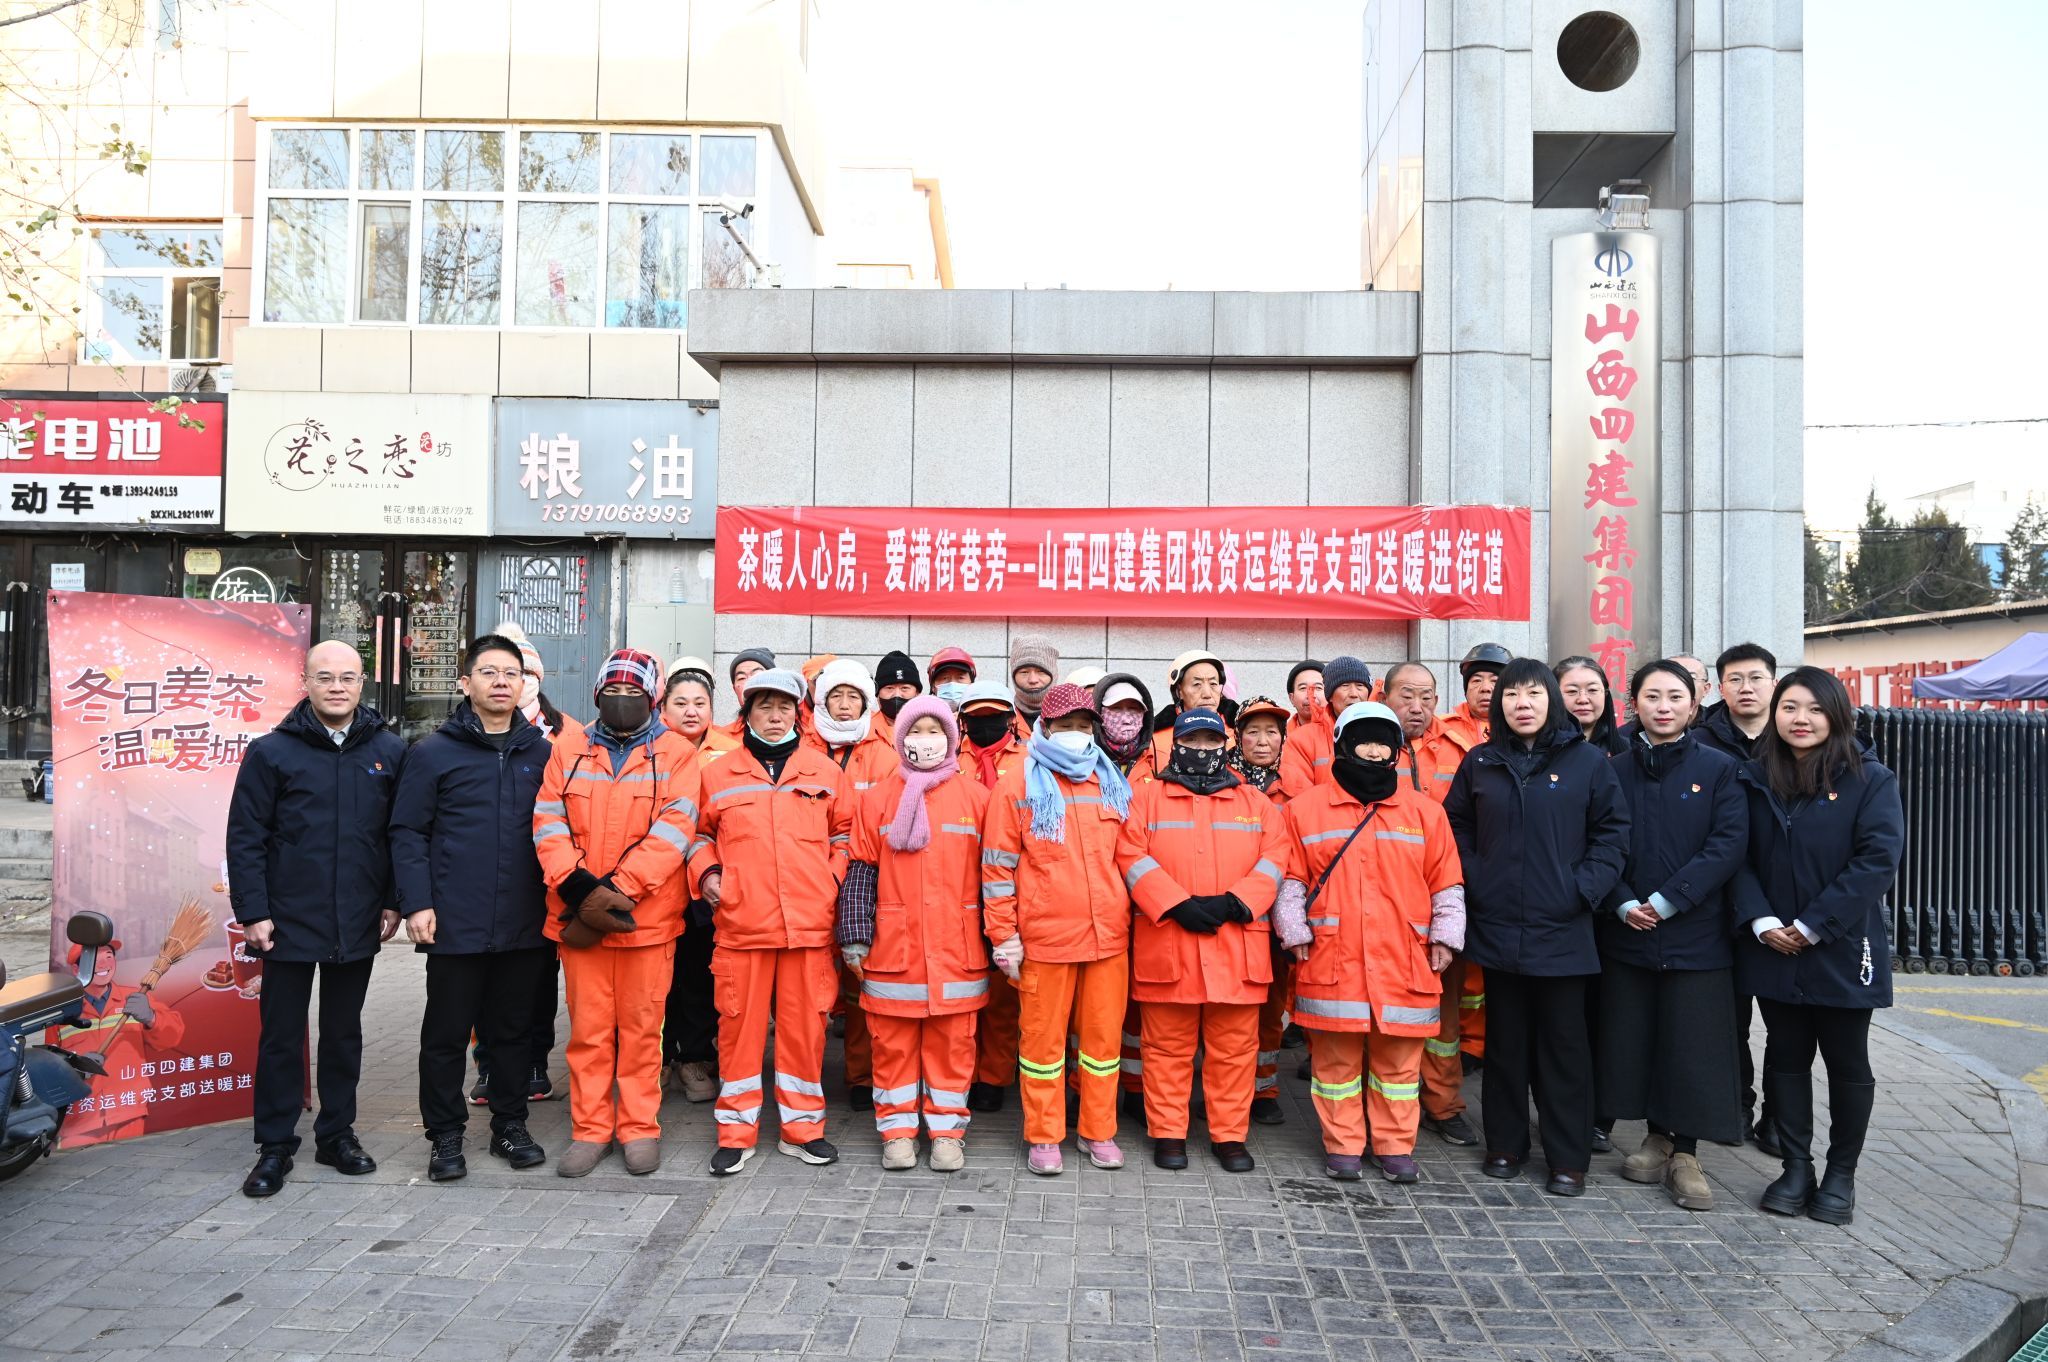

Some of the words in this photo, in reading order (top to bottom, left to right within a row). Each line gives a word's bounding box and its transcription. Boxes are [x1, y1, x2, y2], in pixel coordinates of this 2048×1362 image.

[285, 434, 417, 479] 花之恋
[519, 432, 694, 500] 粮油
[100, 485, 123, 497] 电话
[125, 485, 178, 497] 13934249159
[542, 503, 692, 524] 13191068993
[63, 666, 264, 722] 冬日姜茶
[121, 1052, 233, 1081] 山西四建集团
